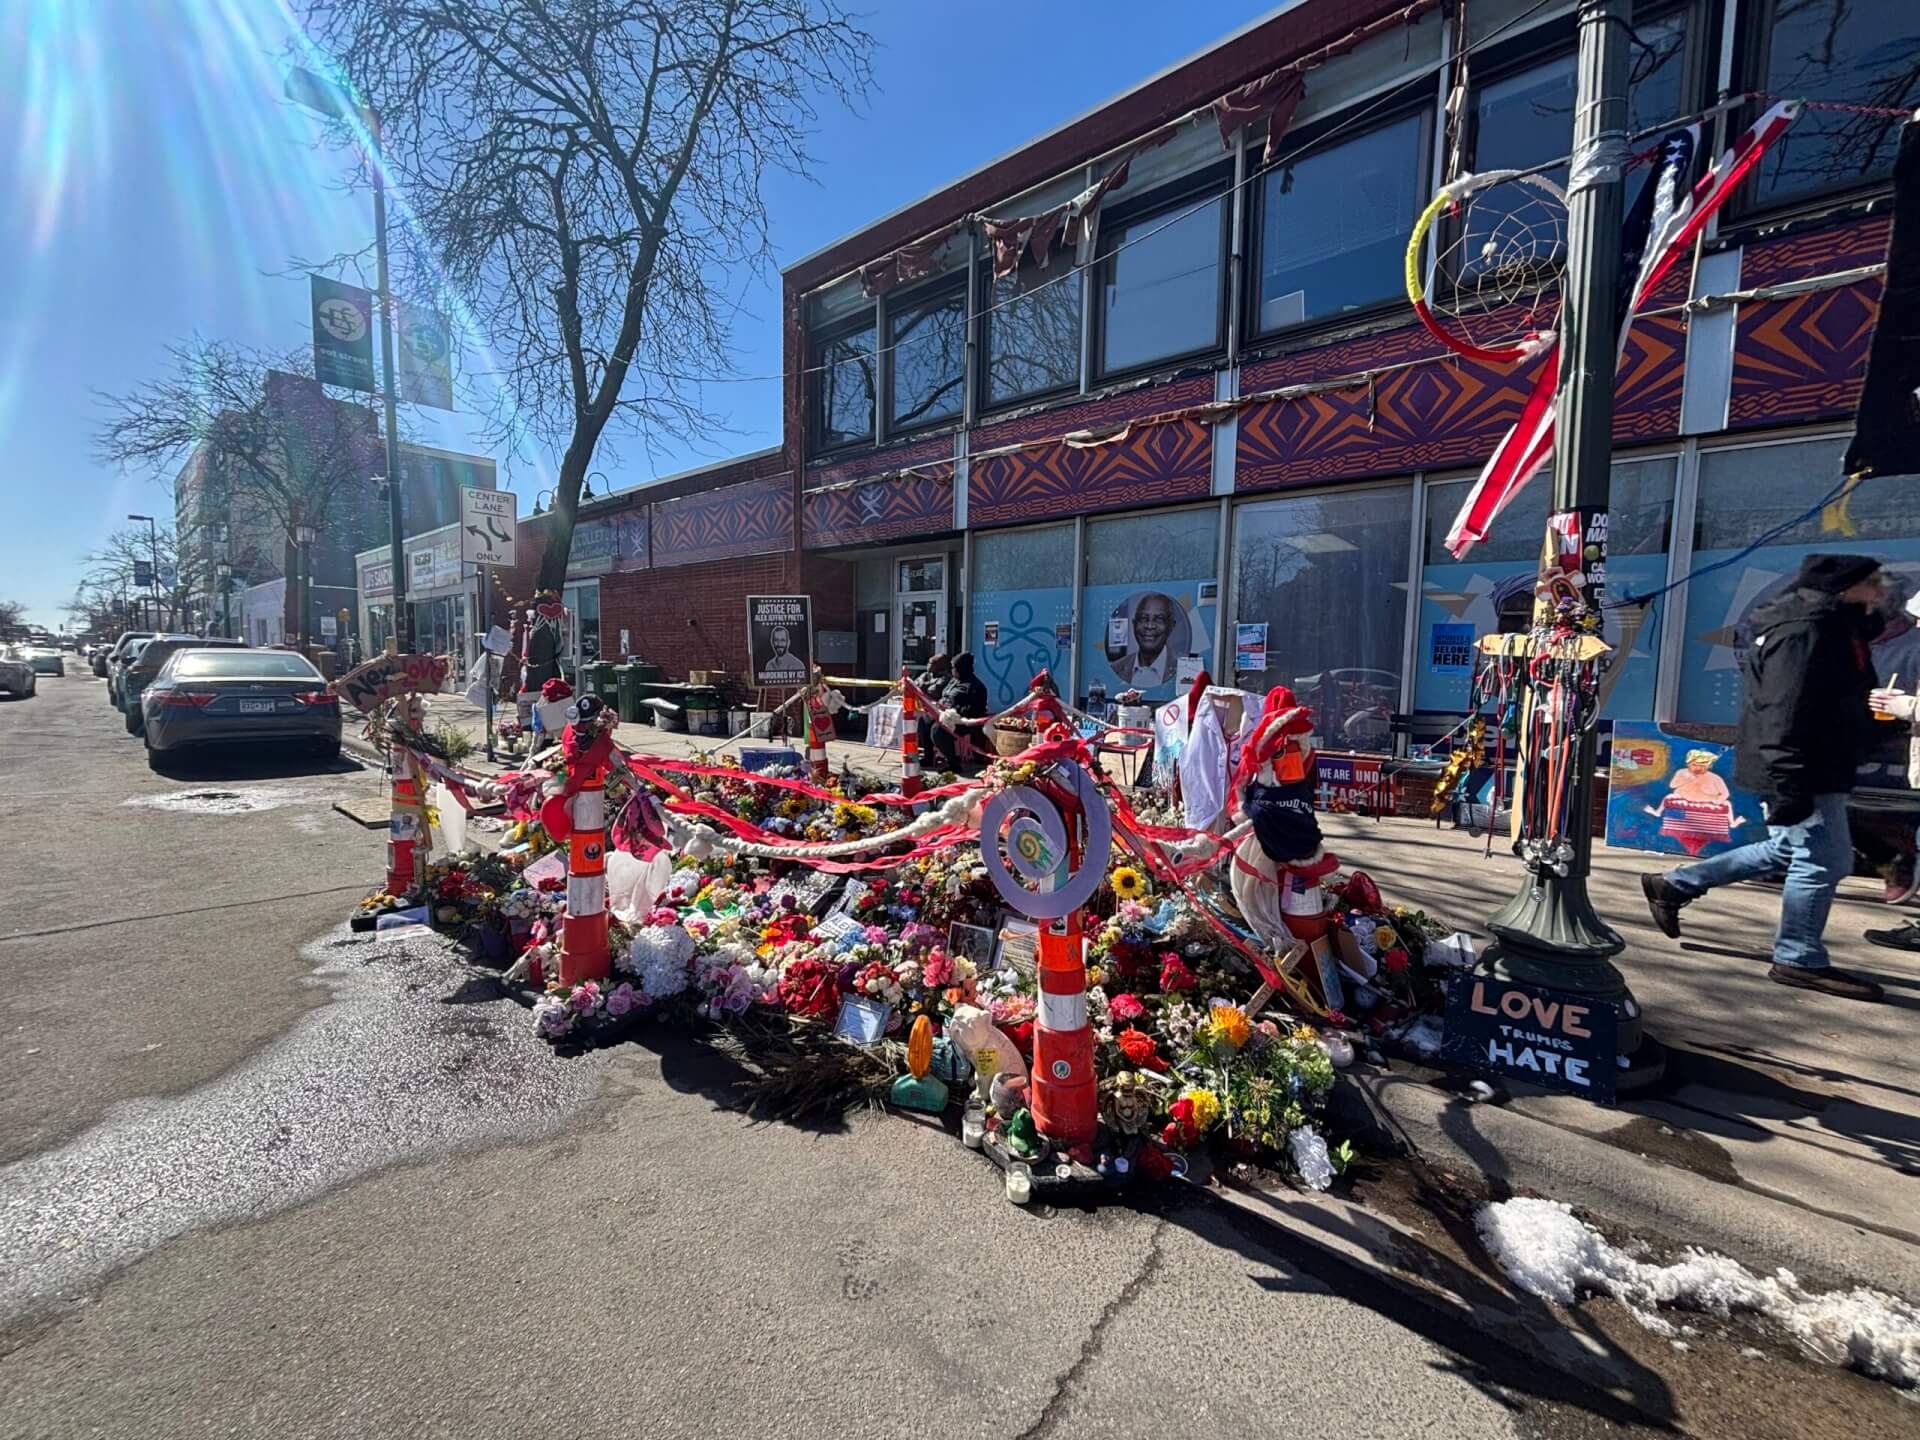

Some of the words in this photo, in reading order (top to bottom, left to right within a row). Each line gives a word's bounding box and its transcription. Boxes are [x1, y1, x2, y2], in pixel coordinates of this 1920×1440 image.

[468, 491, 510, 504] CENTER
[474, 502, 504, 513] LANE
[476, 552, 503, 562] ONLY
[757, 603, 785, 614] JUSTICE
[786, 603, 801, 614] FOR
[754, 614, 767, 622] ALEX
[1433, 645, 1470, 654] BELONG
[1433, 653, 1470, 666] HERE
[758, 671, 788, 680] MURDERED
[788, 671, 796, 679] BY
[796, 670, 806, 679] ICE
[1319, 767, 1333, 779] WE
[1333, 769, 1351, 780] ARE
[1471, 981, 1592, 1039] LOVE
[1499, 1024, 1574, 1051] TRUMPS
[1488, 1038, 1591, 1087] HATE
